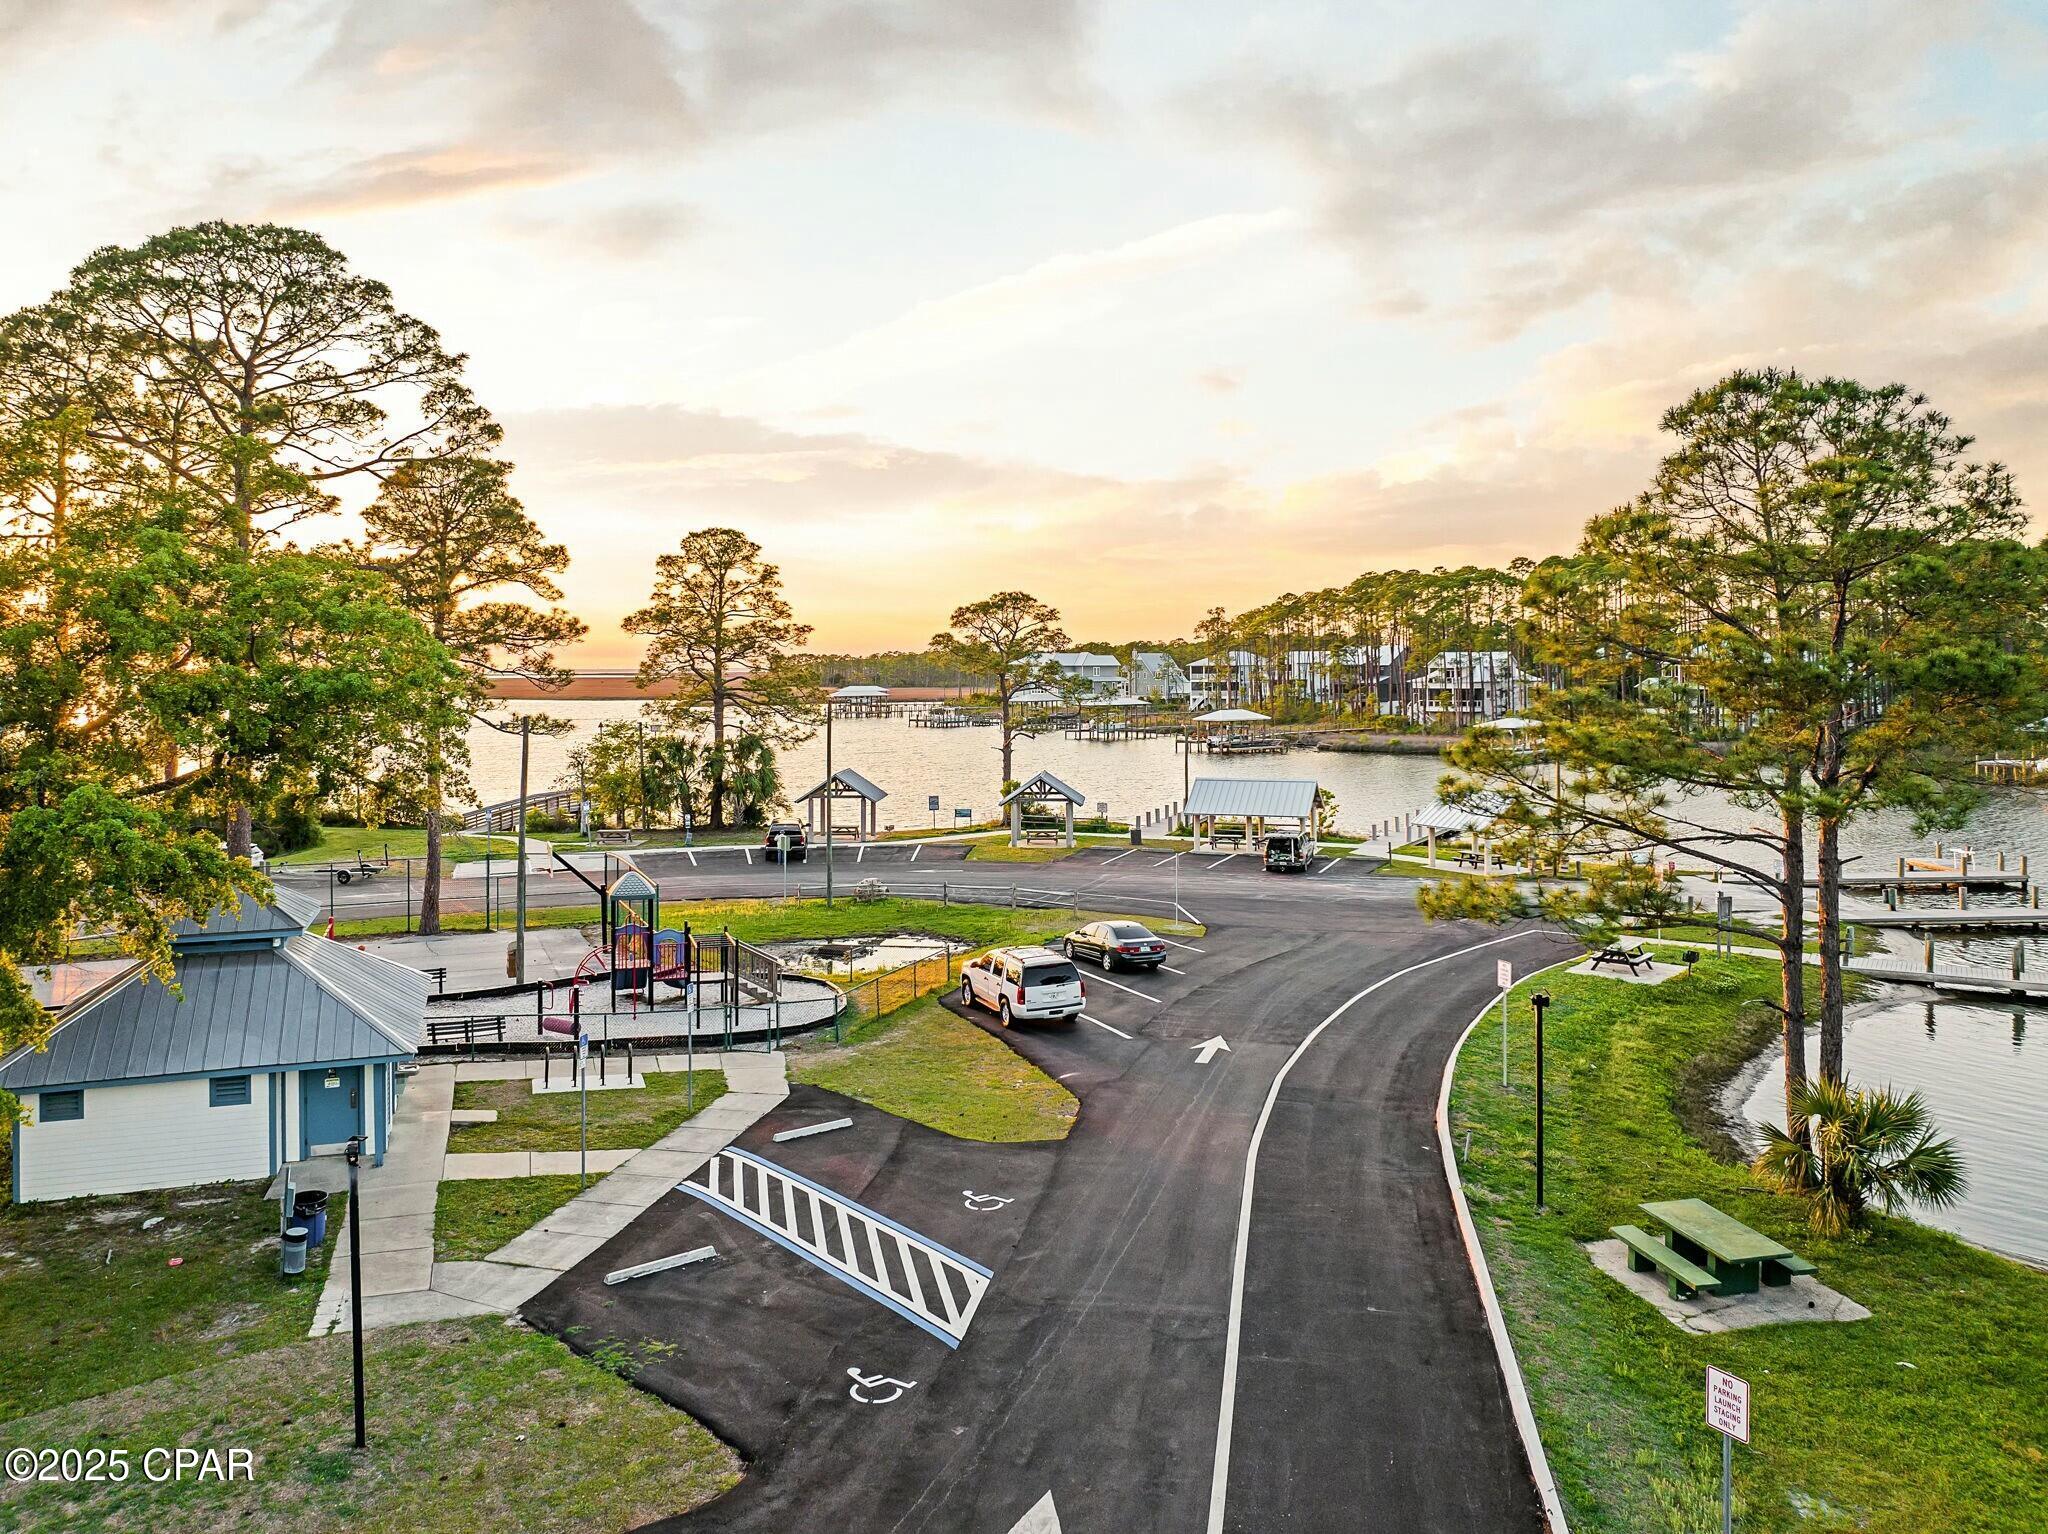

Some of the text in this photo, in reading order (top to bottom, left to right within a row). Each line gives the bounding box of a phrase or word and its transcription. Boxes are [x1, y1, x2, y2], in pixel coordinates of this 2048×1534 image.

[1722, 1377, 1734, 1389] NO
[1713, 1385, 1742, 1404] PARKING
[1714, 1396, 1741, 1413] LAUNCH
[1713, 1405, 1741, 1424] STAGING
[1718, 1418, 1736, 1432] ONLY
